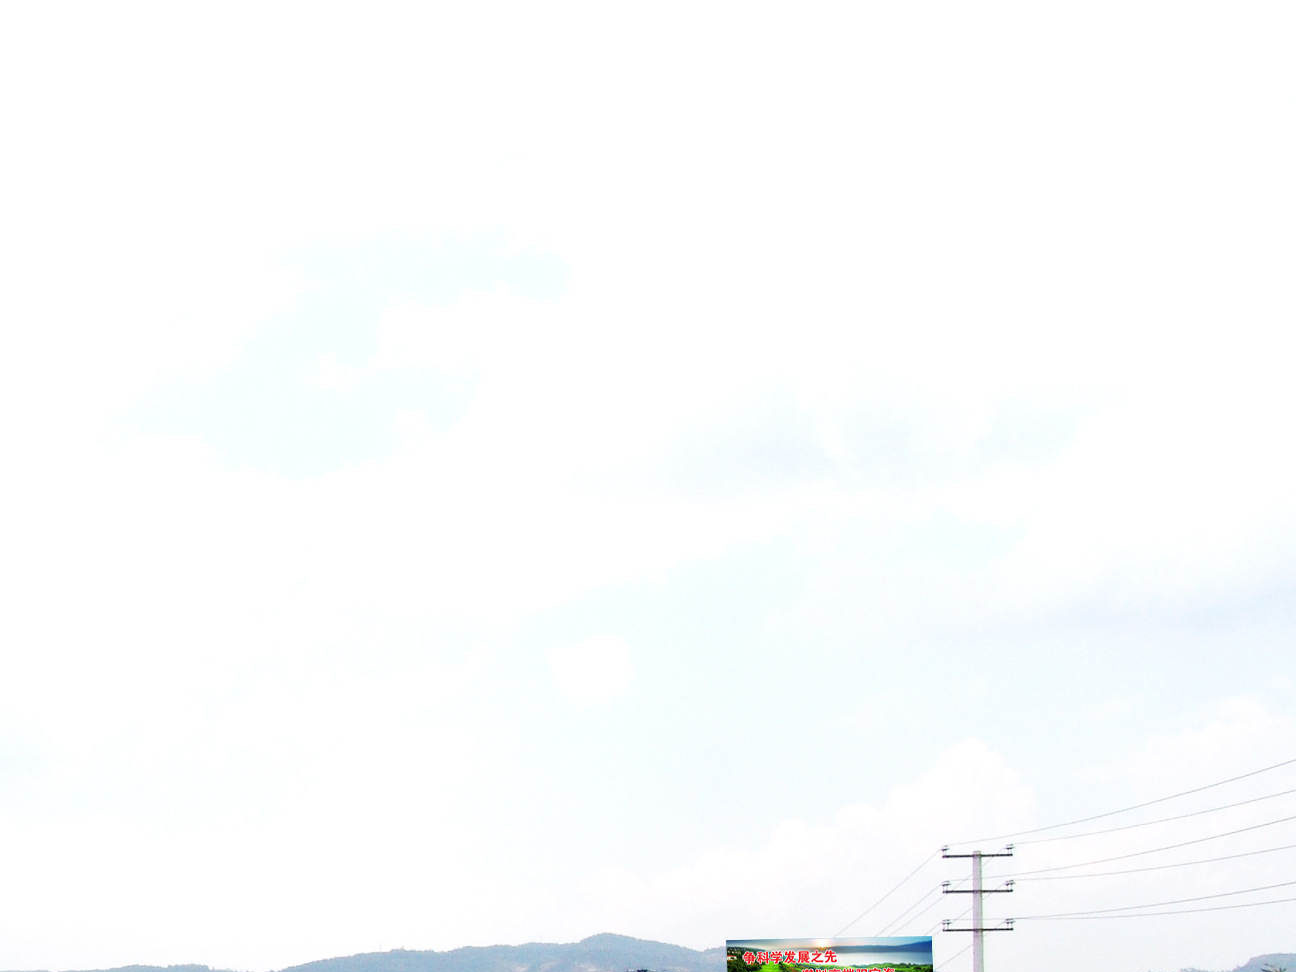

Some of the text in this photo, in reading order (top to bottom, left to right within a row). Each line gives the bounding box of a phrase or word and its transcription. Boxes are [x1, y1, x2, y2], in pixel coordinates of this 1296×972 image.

[742, 949, 837, 965] 争科学发展之先
